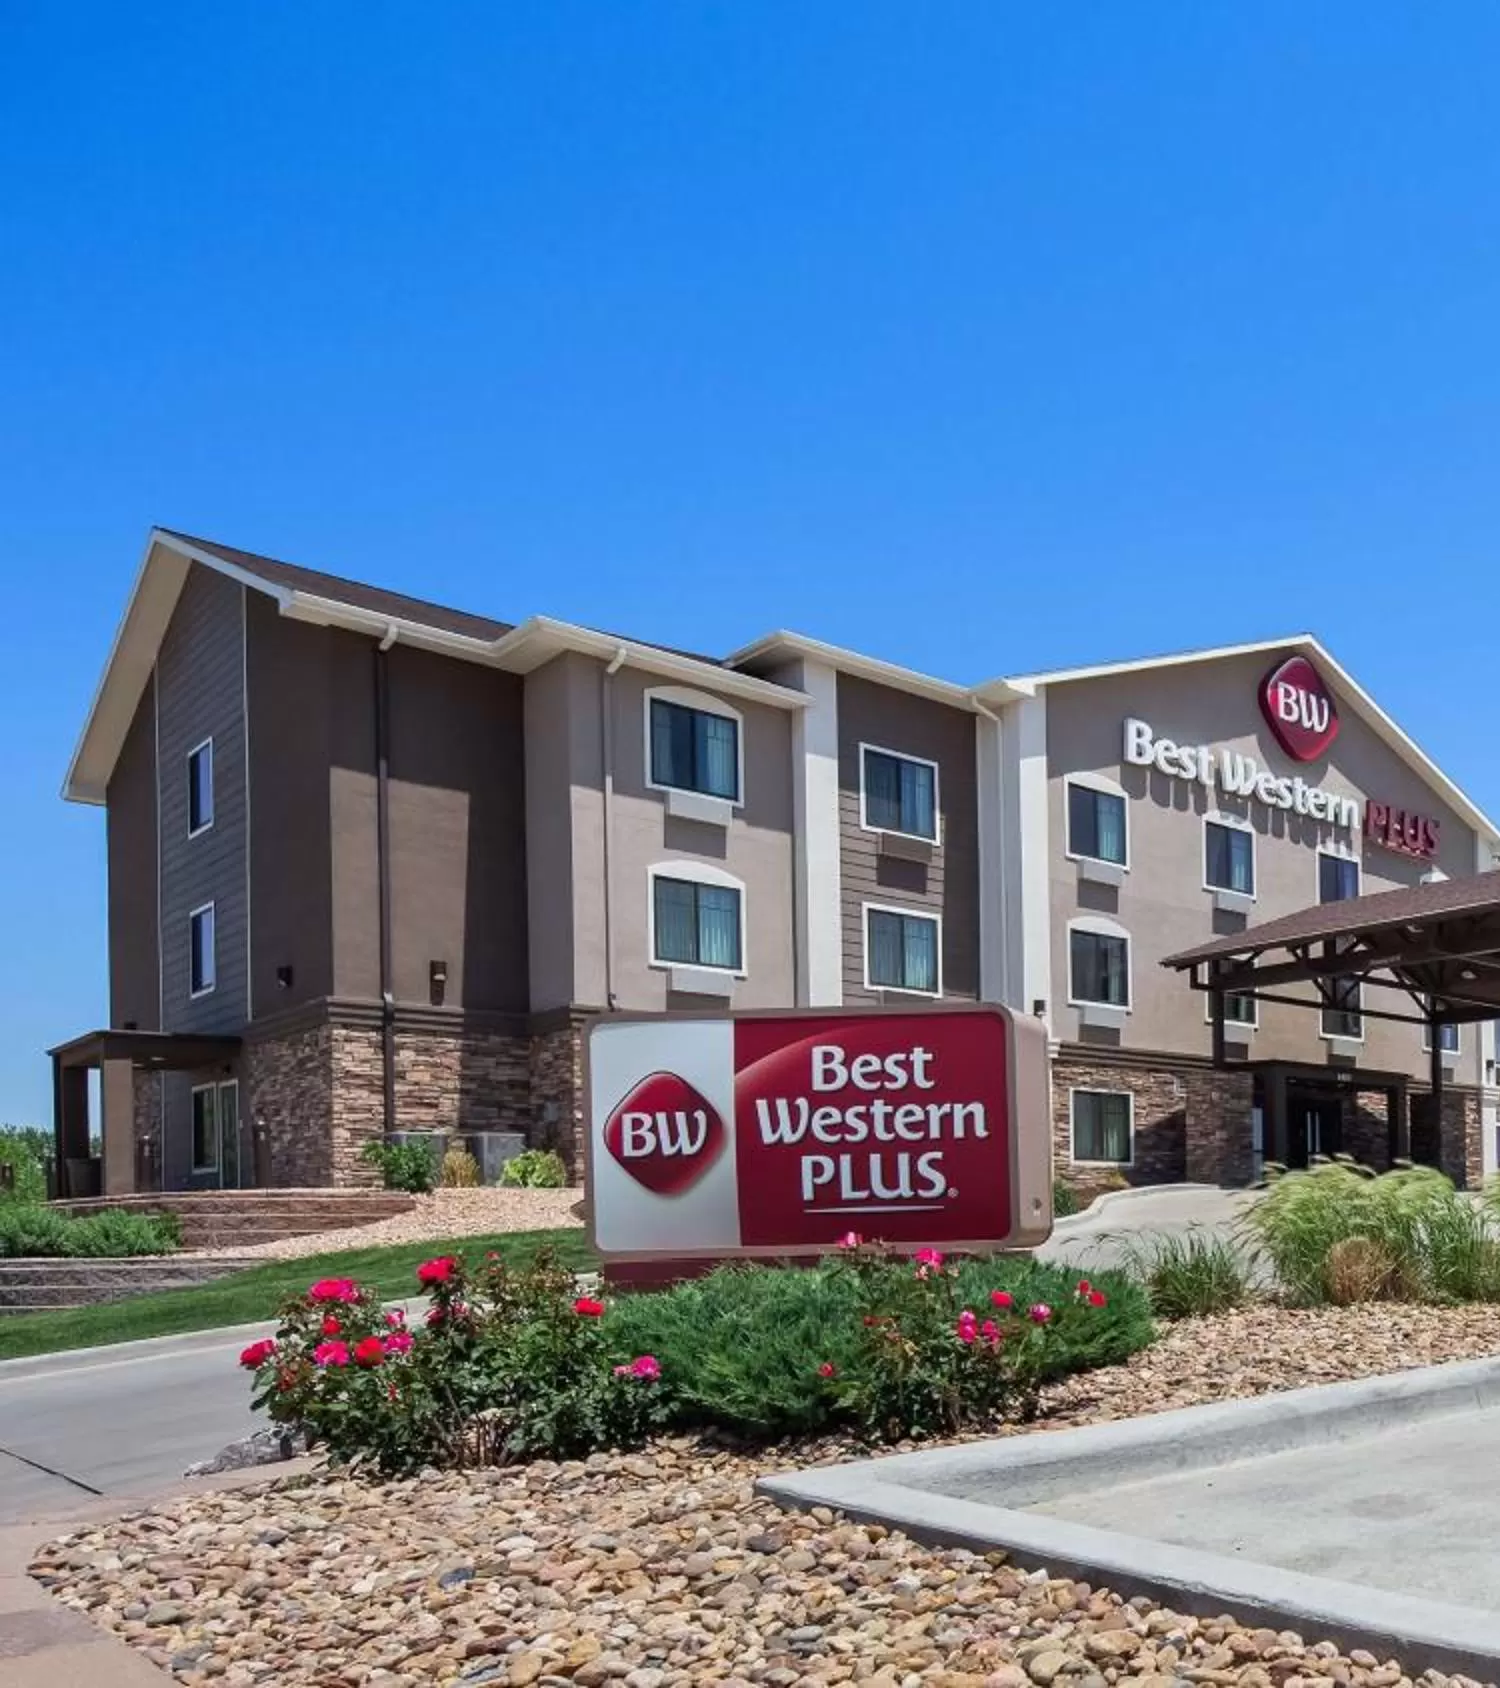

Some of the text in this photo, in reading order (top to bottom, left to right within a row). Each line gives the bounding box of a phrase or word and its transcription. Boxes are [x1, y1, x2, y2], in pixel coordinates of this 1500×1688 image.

[1277, 682, 1329, 733] BW
[1123, 716, 1441, 858] Best Western PLUS
[811, 1045, 935, 1092] Best
[621, 1110, 708, 1158] BW
[756, 1097, 990, 1144] Western
